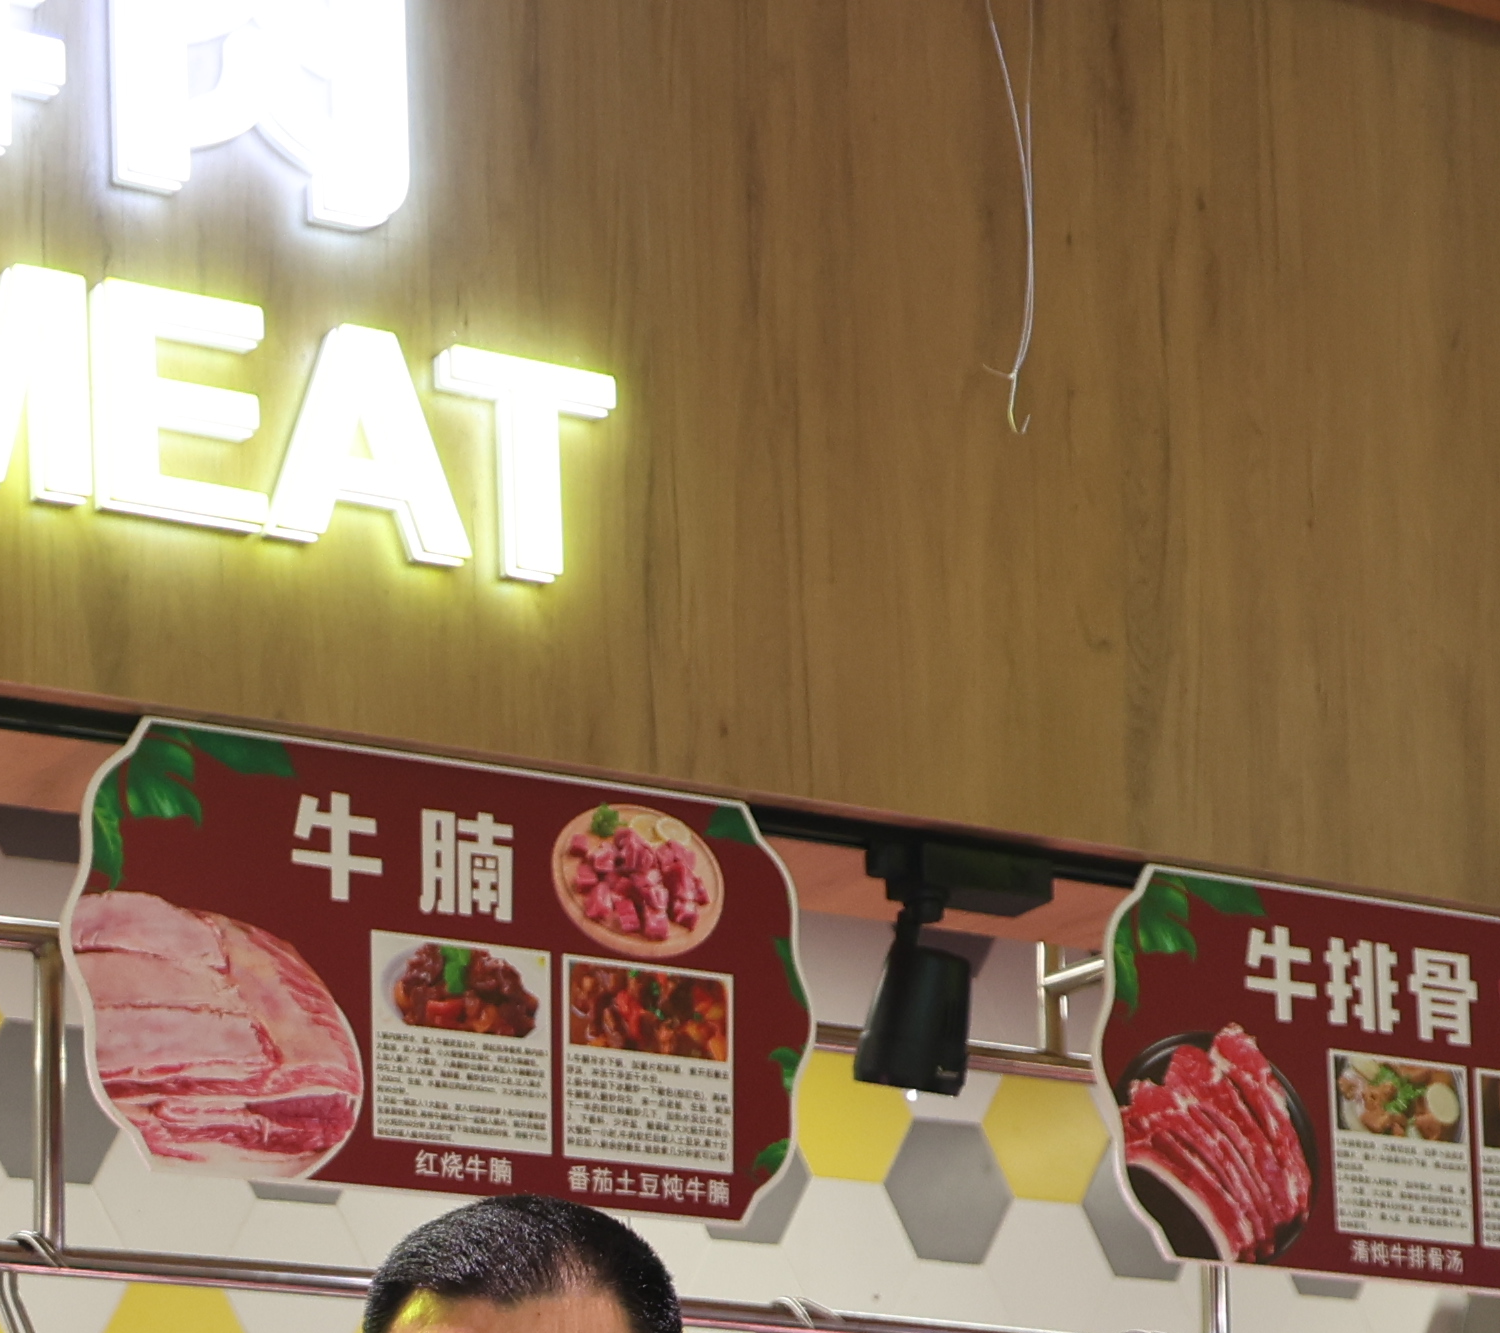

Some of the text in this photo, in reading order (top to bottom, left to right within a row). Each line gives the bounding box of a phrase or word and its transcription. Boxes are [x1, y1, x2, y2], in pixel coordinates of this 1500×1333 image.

[291, 792, 514, 923] 牛腩
[1243, 926, 1478, 1048] 牛排骨
[414, 1148, 513, 1186] 红烧牛腩
[567, 1165, 730, 1206] 番茄土豆炖牛腩
[1350, 1239, 1464, 1275] 清炖牛排骨汤
